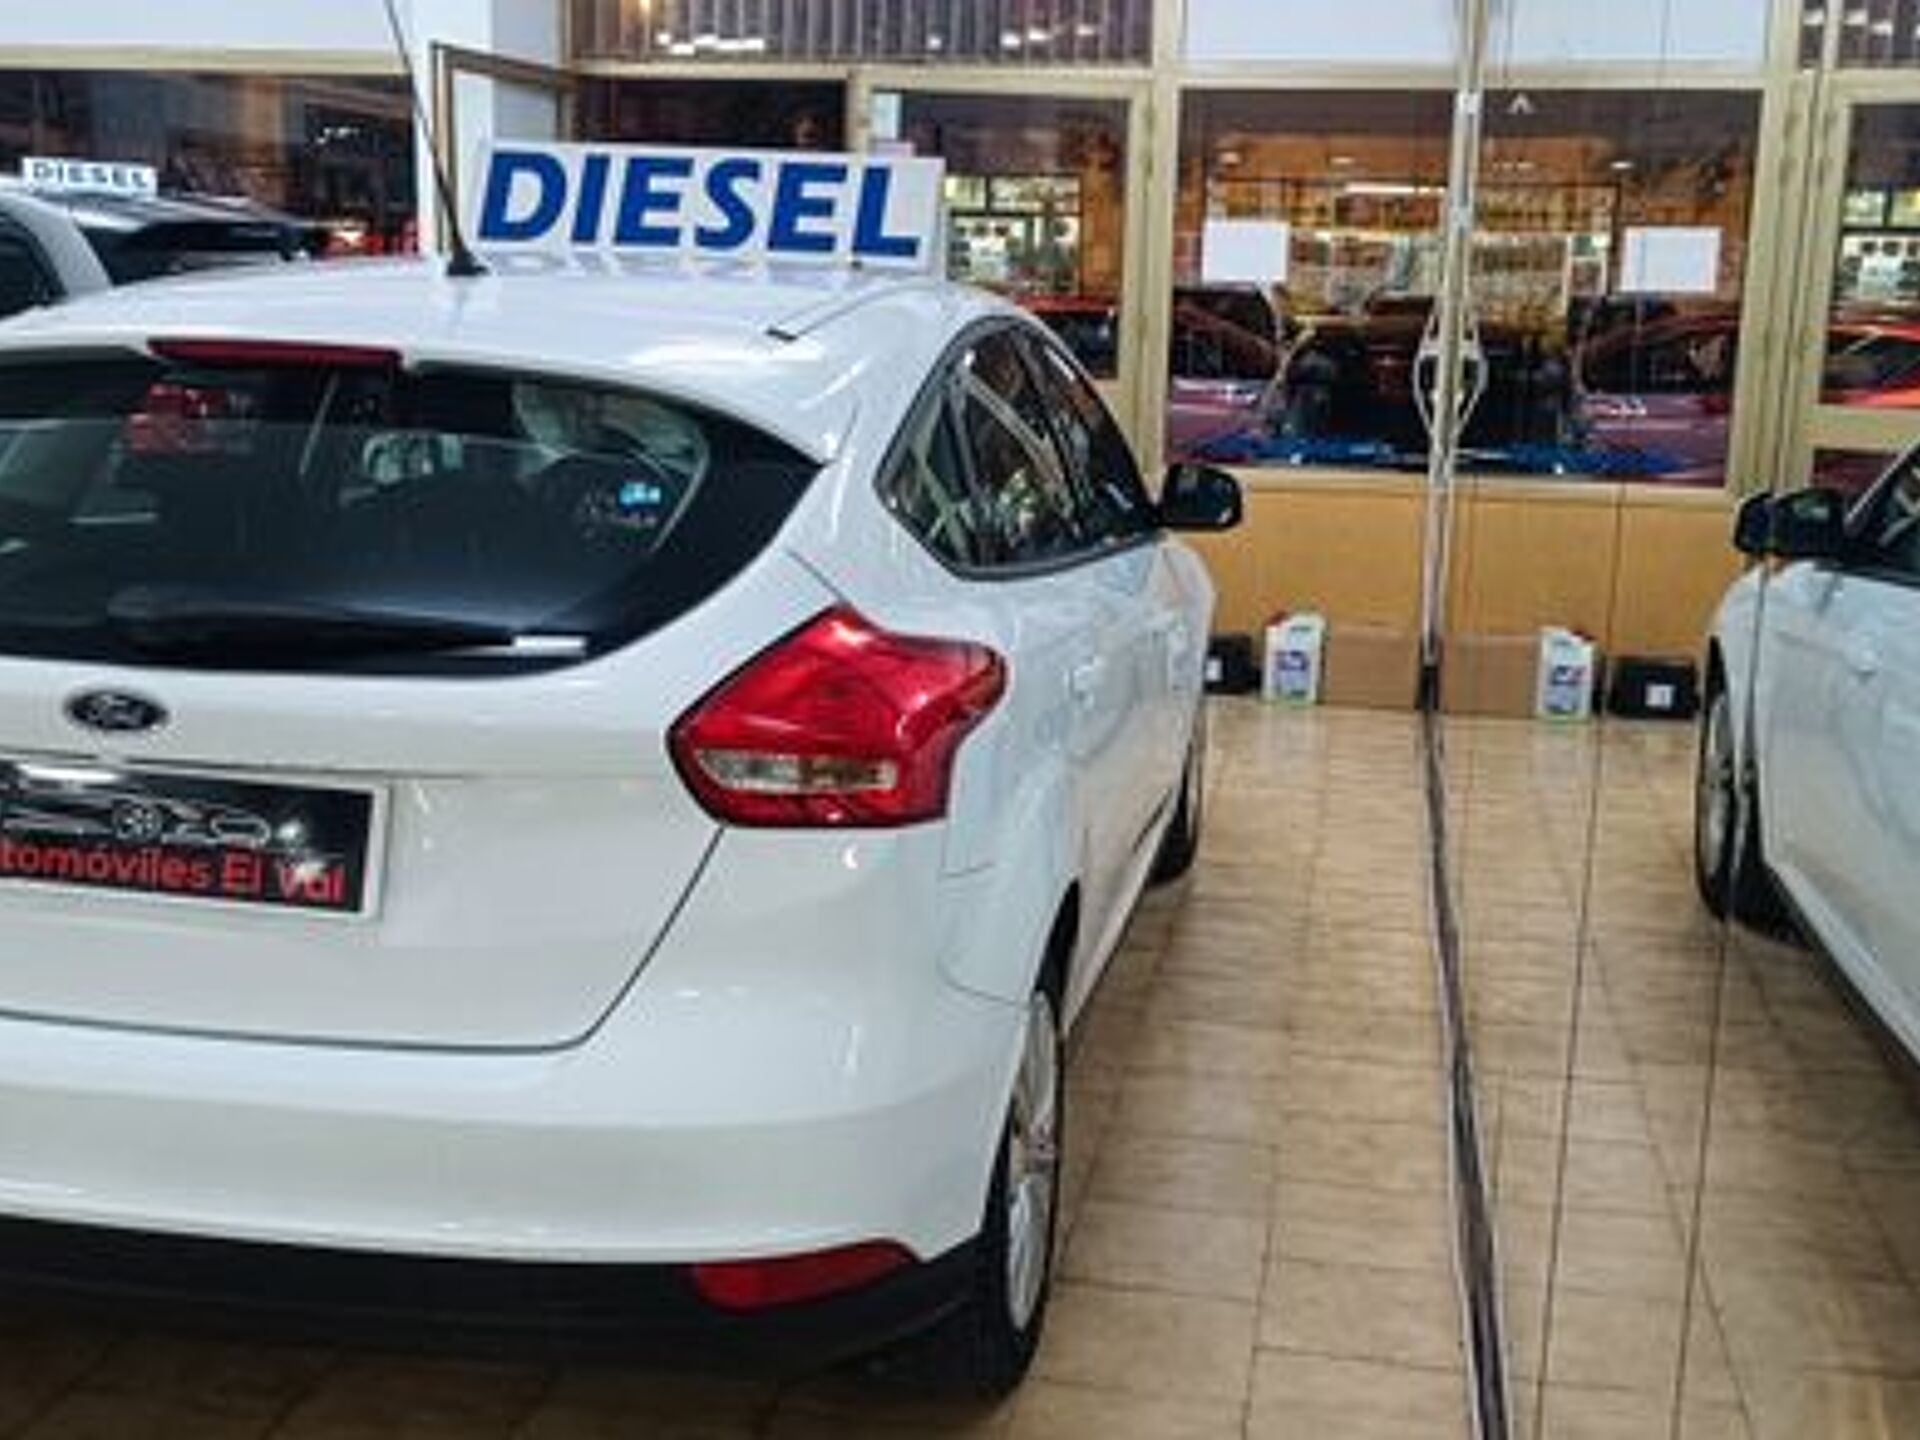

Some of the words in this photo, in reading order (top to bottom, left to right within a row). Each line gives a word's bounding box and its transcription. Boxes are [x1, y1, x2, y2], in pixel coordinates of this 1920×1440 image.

[32, 161, 148, 188] DIESEL
[476, 149, 921, 259] DIESEL
[223, 851, 263, 894] El
